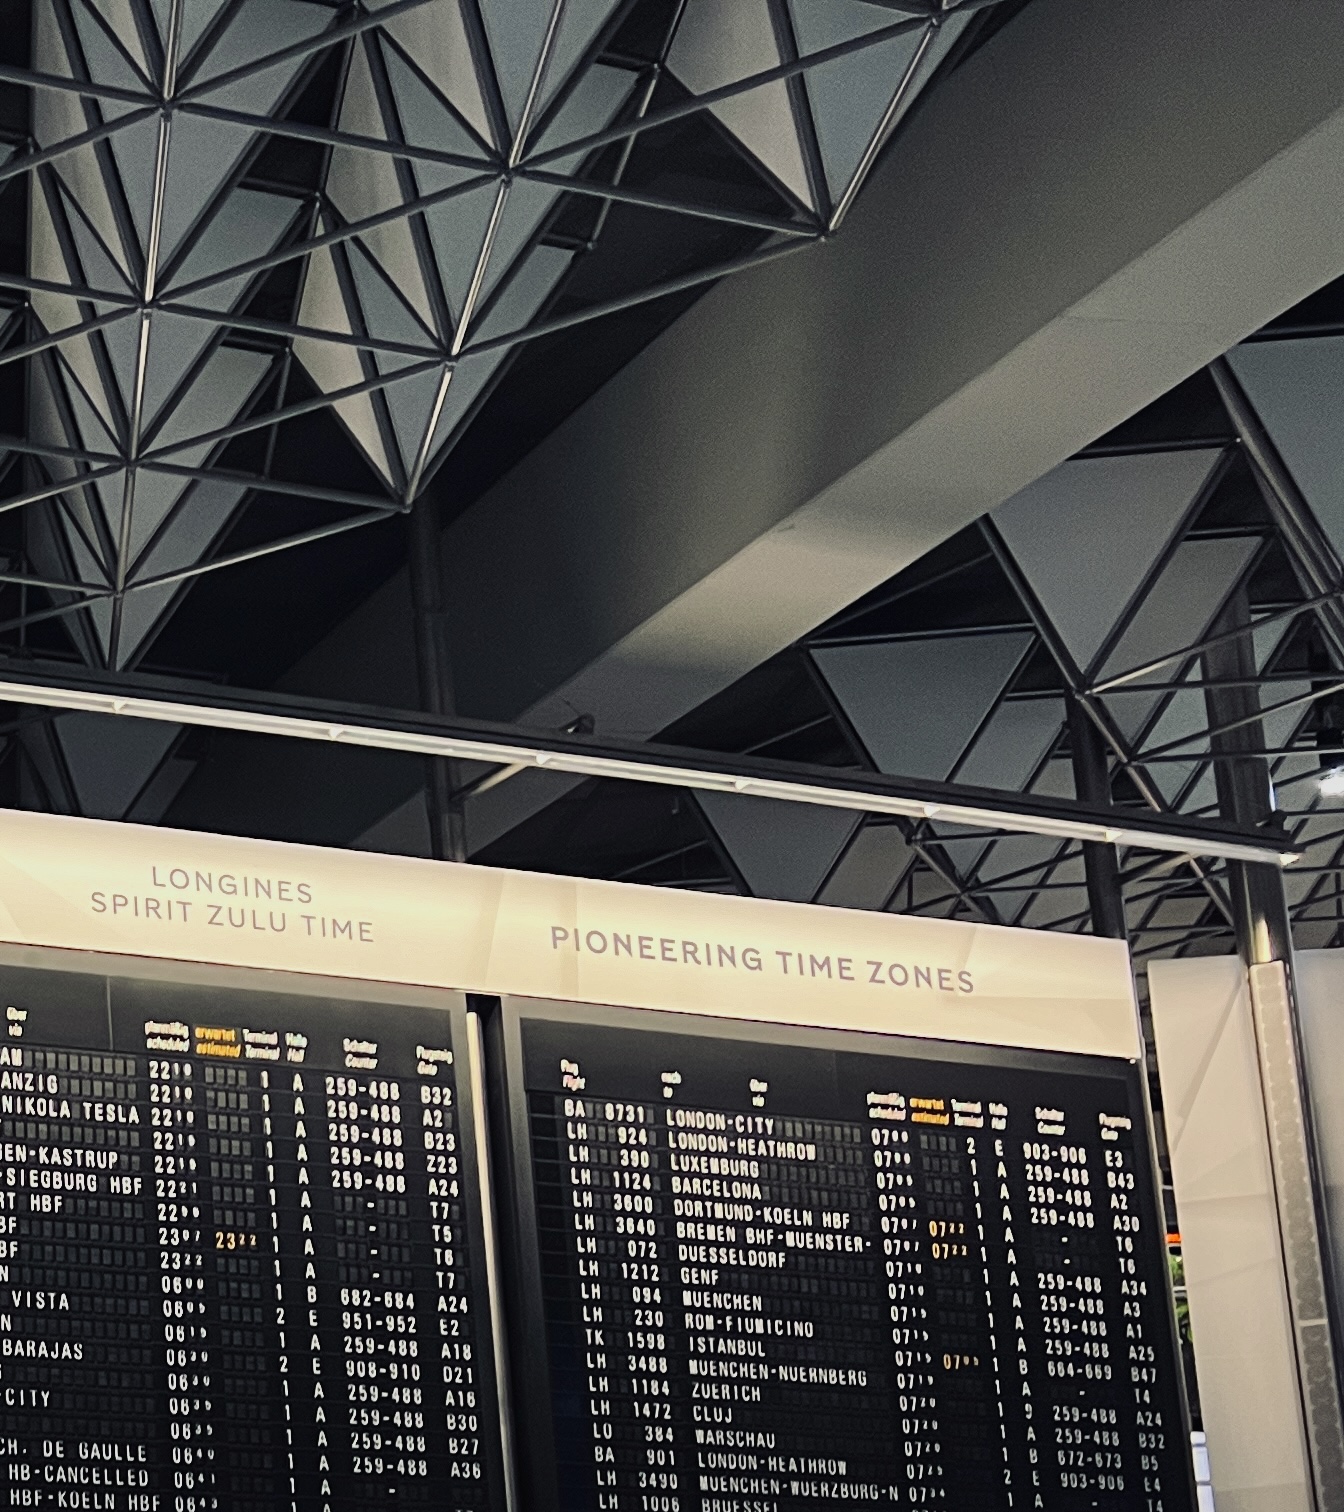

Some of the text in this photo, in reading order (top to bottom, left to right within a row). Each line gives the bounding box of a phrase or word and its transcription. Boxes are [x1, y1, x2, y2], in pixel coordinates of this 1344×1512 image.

[151, 865, 313, 904] LONGINES
[91, 891, 374, 943] SPIRIT ZULU TIME
[551, 926, 974, 994] PIONEERING TIME ZONES
[0, 1093, 71, 1119] NIKOLA
[81, 1100, 140, 1125] TESLA
[616, 1125, 816, 1161] 924 LONDON-HEATHROW
[584, 1327, 604, 1346] TK
[688, 1335, 766, 1357] ISTANBUL
[694, 1428, 775, 1449] WARSCHAU
